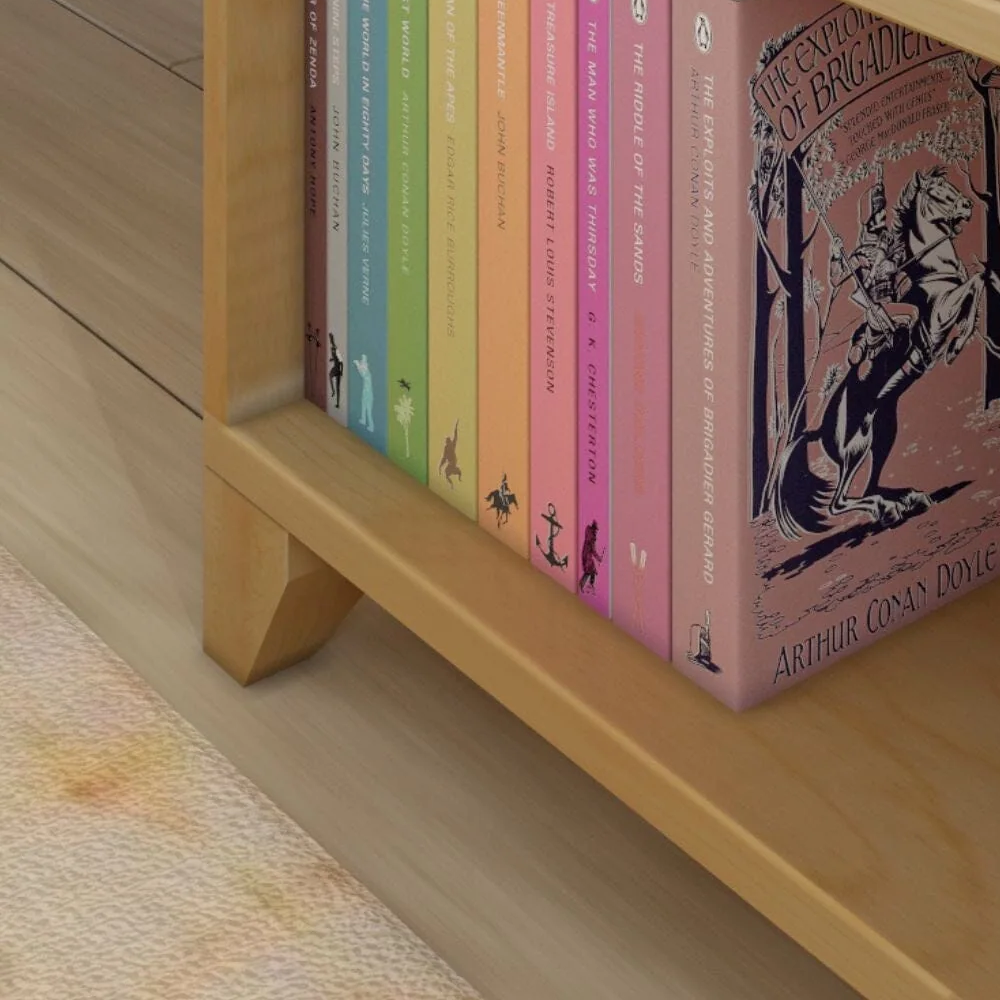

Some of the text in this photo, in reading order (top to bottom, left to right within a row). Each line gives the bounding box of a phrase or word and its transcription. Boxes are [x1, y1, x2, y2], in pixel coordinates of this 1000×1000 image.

[309, 11, 317, 33] OF
[361, 17, 370, 72] WORLD
[446, 26, 455, 44] OF
[587, 21, 597, 53] THE
[309, 36, 317, 89] ZENDA
[331, 35, 340, 86] STEPS
[401, 20, 410, 78] WORLD
[446, 49, 455, 82] THE
[361, 76, 370, 92] IN
[446, 85, 455, 123] APES
[587, 60, 597, 101] MAN
[758, 55, 799, 108] THE
[309, 105, 317, 169] ANTONY
[331, 105, 340, 151] JOHN
[361, 97, 370, 150] EIGHTY
[401, 91, 410, 155] ARTHUR
[497, 111, 506, 155] JOHN
[587, 108, 597, 149] WHO
[779, 90, 808, 141] OF
[361, 155, 370, 194] DAYS
[446, 136, 455, 188] EDGAR
[587, 157, 597, 196] WAS
[633, 42, 643, 286] THE RIDDLE OF THE SANDS
[690, 67, 700, 274] ARTHUR CONAN DOYLE
[309, 175, 317, 218] HOPE
[331, 159, 340, 232] BUCHAN
[401, 162, 410, 217] CONAN
[446, 196, 455, 234] RICE
[497, 161, 506, 231] BUCHAN
[545, 2, 555, 394] TREASURE ISLAND ROBERT LOUIS STEVENSON
[401, 223, 410, 276] DOYLE
[361, 258, 370, 305] VERNE
[446, 237, 455, 338] BURROUGHS
[703, 75, 713, 584] THE EXPLOITS AND ADVENTURES OF BRIGADIER GERARD
[587, 363, 597, 485] CHESTERTON
[773, 542, 999, 684] ARTHUR CONAN DOYLE
